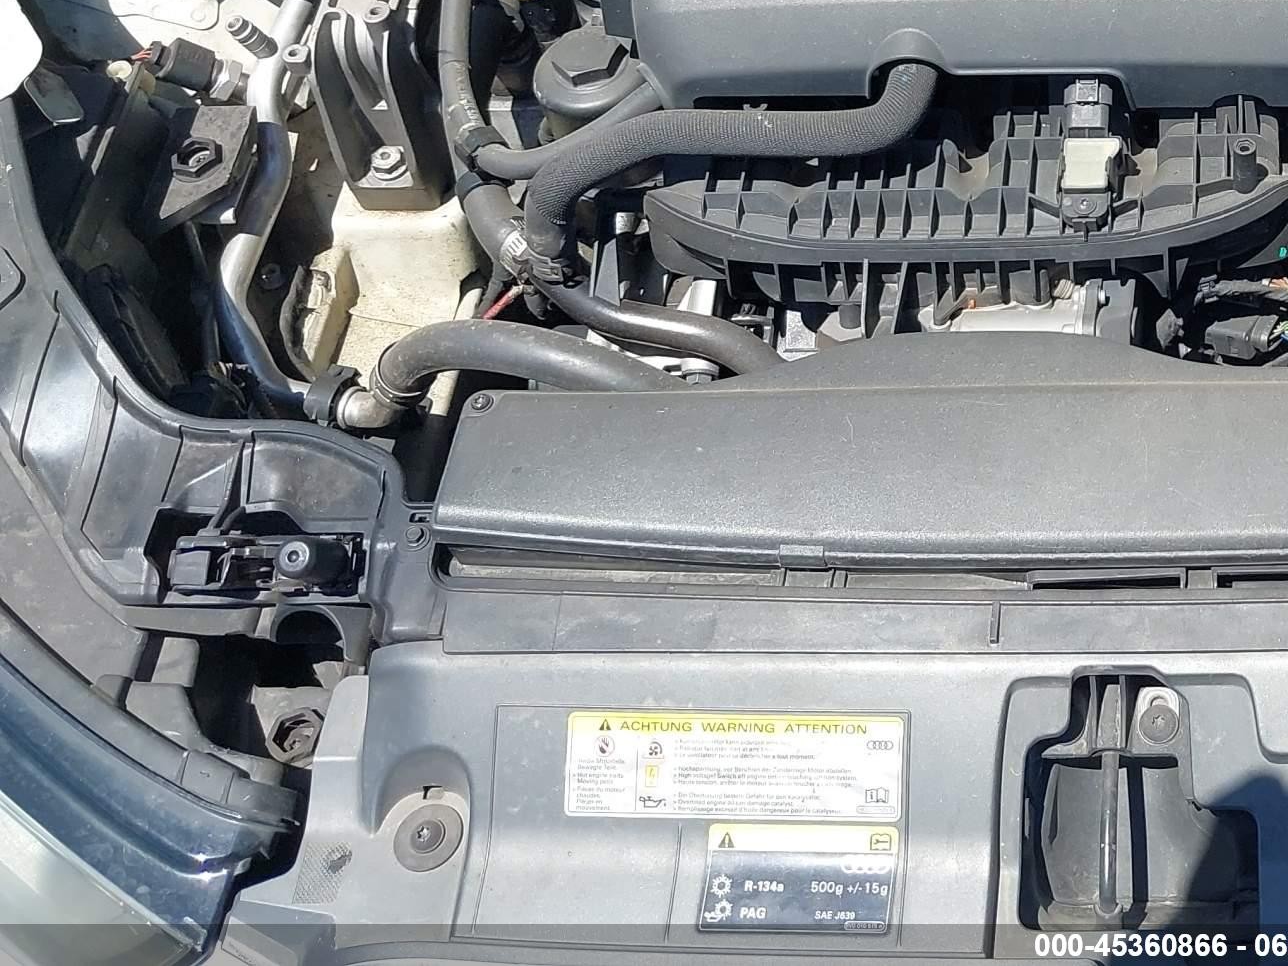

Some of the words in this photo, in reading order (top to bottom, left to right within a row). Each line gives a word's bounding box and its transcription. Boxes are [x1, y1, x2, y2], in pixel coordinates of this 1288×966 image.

[620, 721, 692, 732] ACHTUNG
[702, 722, 775, 734] WARNING
[785, 723, 867, 734] ATTENTION
[743, 880, 785, 892] R-134a
[811, 881, 844, 895] 500g
[739, 907, 767, 919] PAG
[814, 911, 833, 920] SAE
